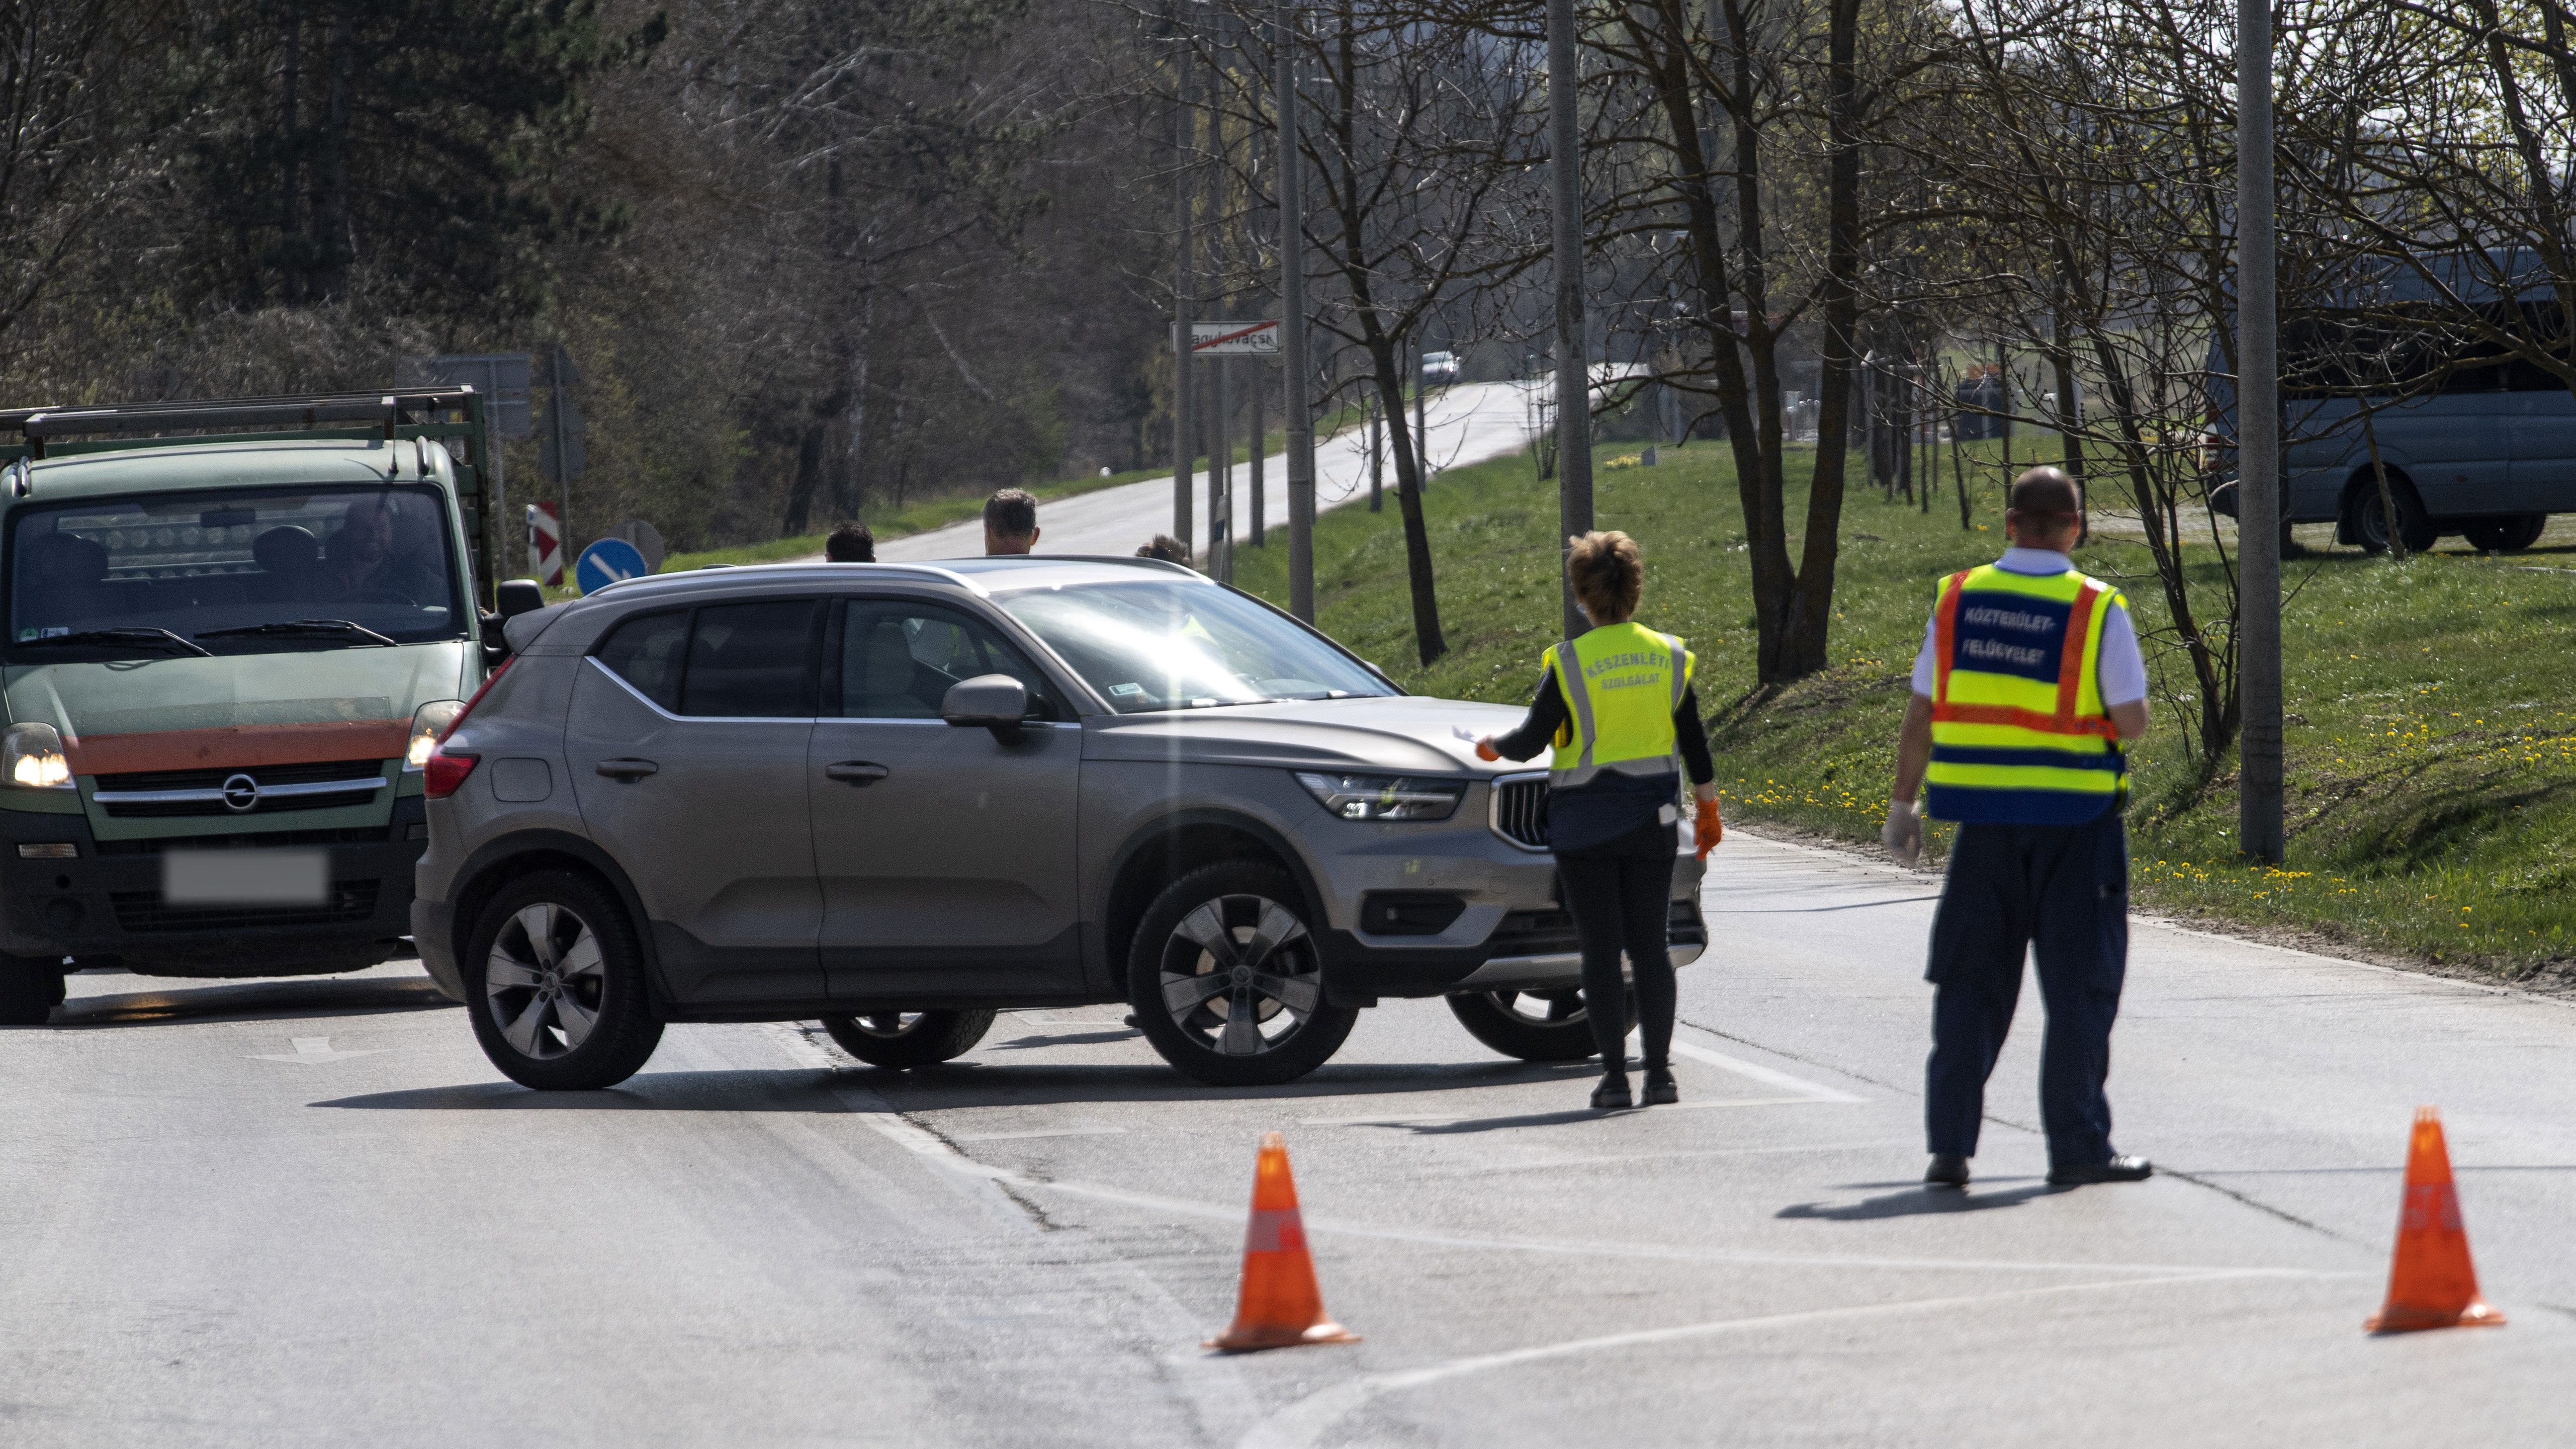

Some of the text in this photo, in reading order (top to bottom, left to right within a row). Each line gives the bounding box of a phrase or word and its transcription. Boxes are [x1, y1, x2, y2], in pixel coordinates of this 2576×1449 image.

[1962, 638, 2045, 664] FELÜGYELET
[1586, 651, 1670, 679] KÉSZENLÉTI
[1602, 673, 1661, 690] SZOLGÁLAT
